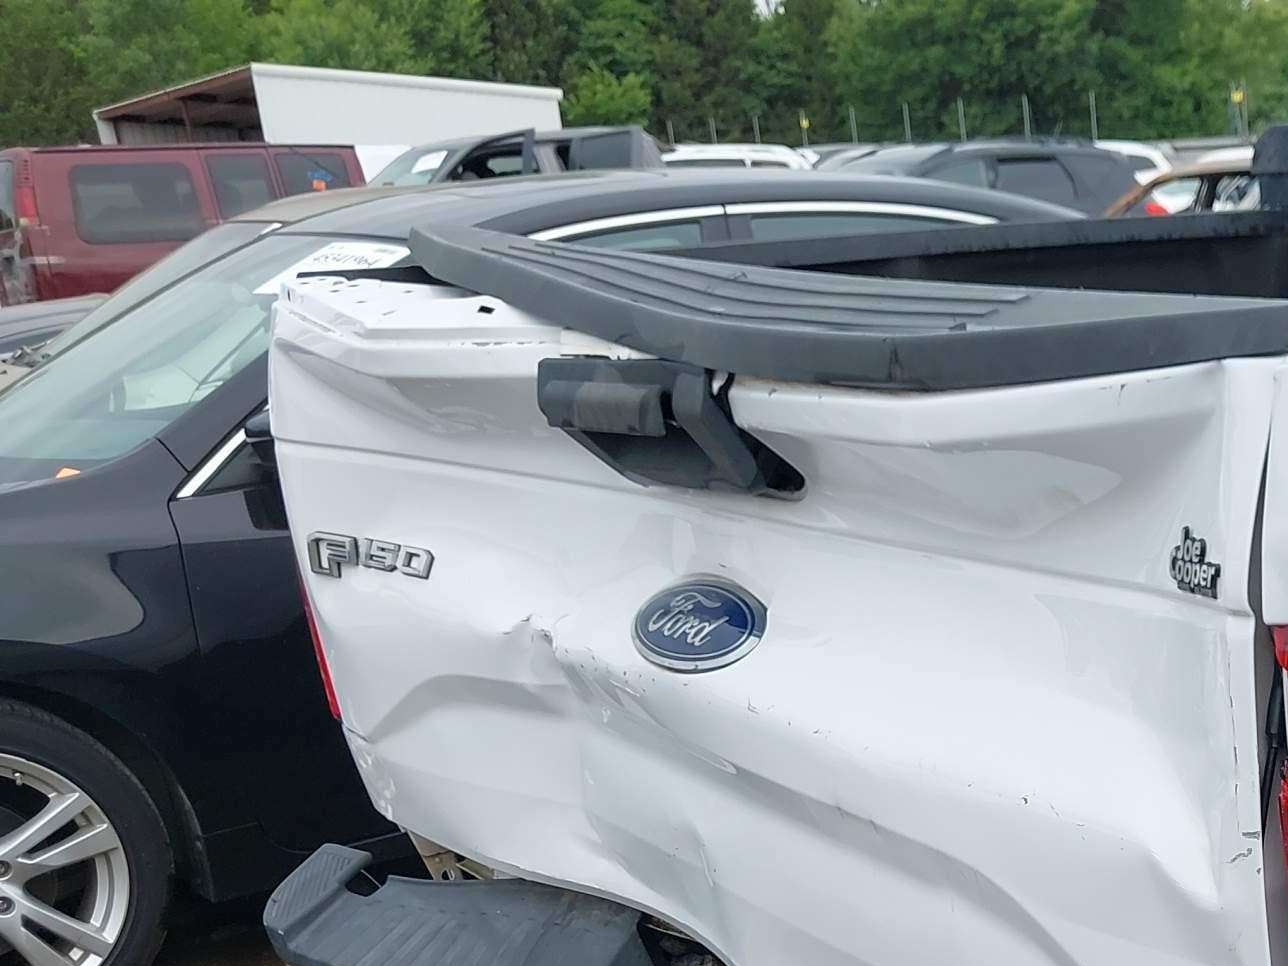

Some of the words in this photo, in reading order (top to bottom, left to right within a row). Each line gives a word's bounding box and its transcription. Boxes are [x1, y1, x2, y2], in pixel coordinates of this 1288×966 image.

[1175, 526, 1203, 562] Joe
[1169, 545, 1217, 588] Cooper
[648, 591, 730, 647] Ford
